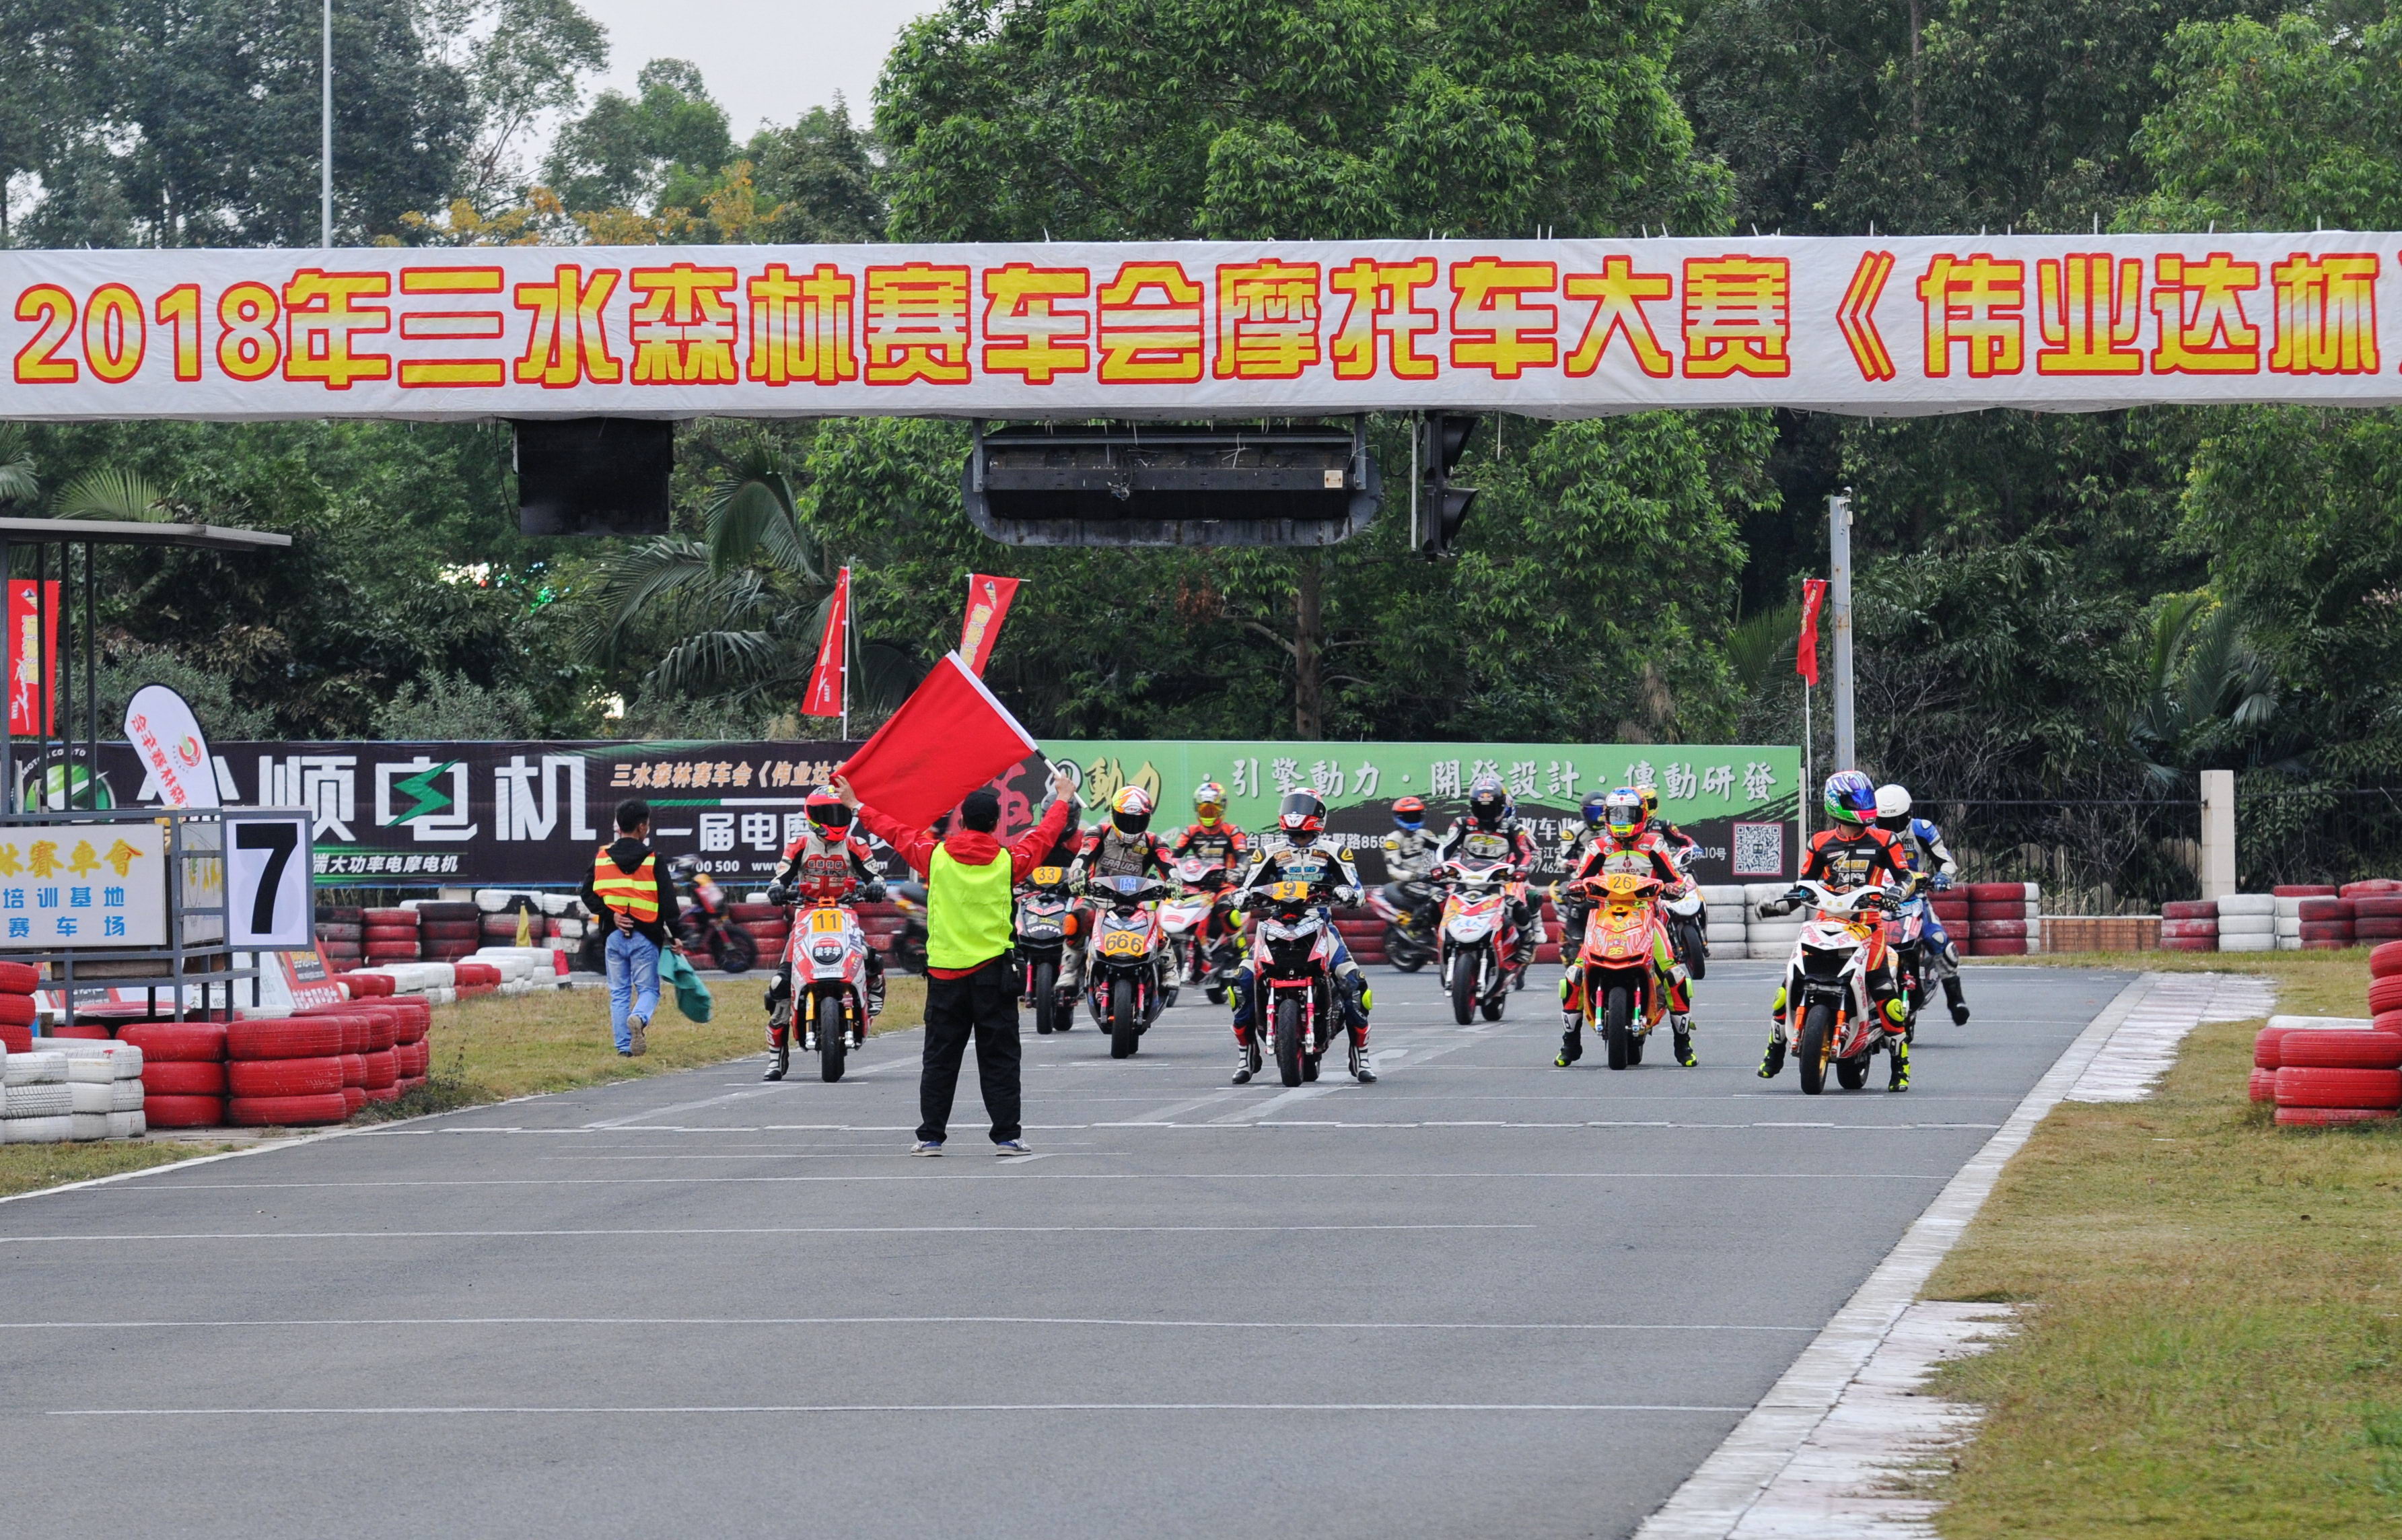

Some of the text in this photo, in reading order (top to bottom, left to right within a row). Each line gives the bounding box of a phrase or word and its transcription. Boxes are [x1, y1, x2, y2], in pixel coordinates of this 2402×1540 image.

[13, 250, 2402, 390] 2018年三水森林赛车会摩托车大赛《伟业达杯
[715, 860, 740, 872] 500
[1100, 857, 1141, 873] GARUDA
[236, 823, 297, 934] 7
[1038, 868, 1055, 881] 33
[1283, 882, 1296, 897] 9
[1613, 876, 1633, 890] 26
[817, 913, 838, 930] 11
[1106, 934, 1143, 954] 666
[1608, 947, 1624, 956] 26
